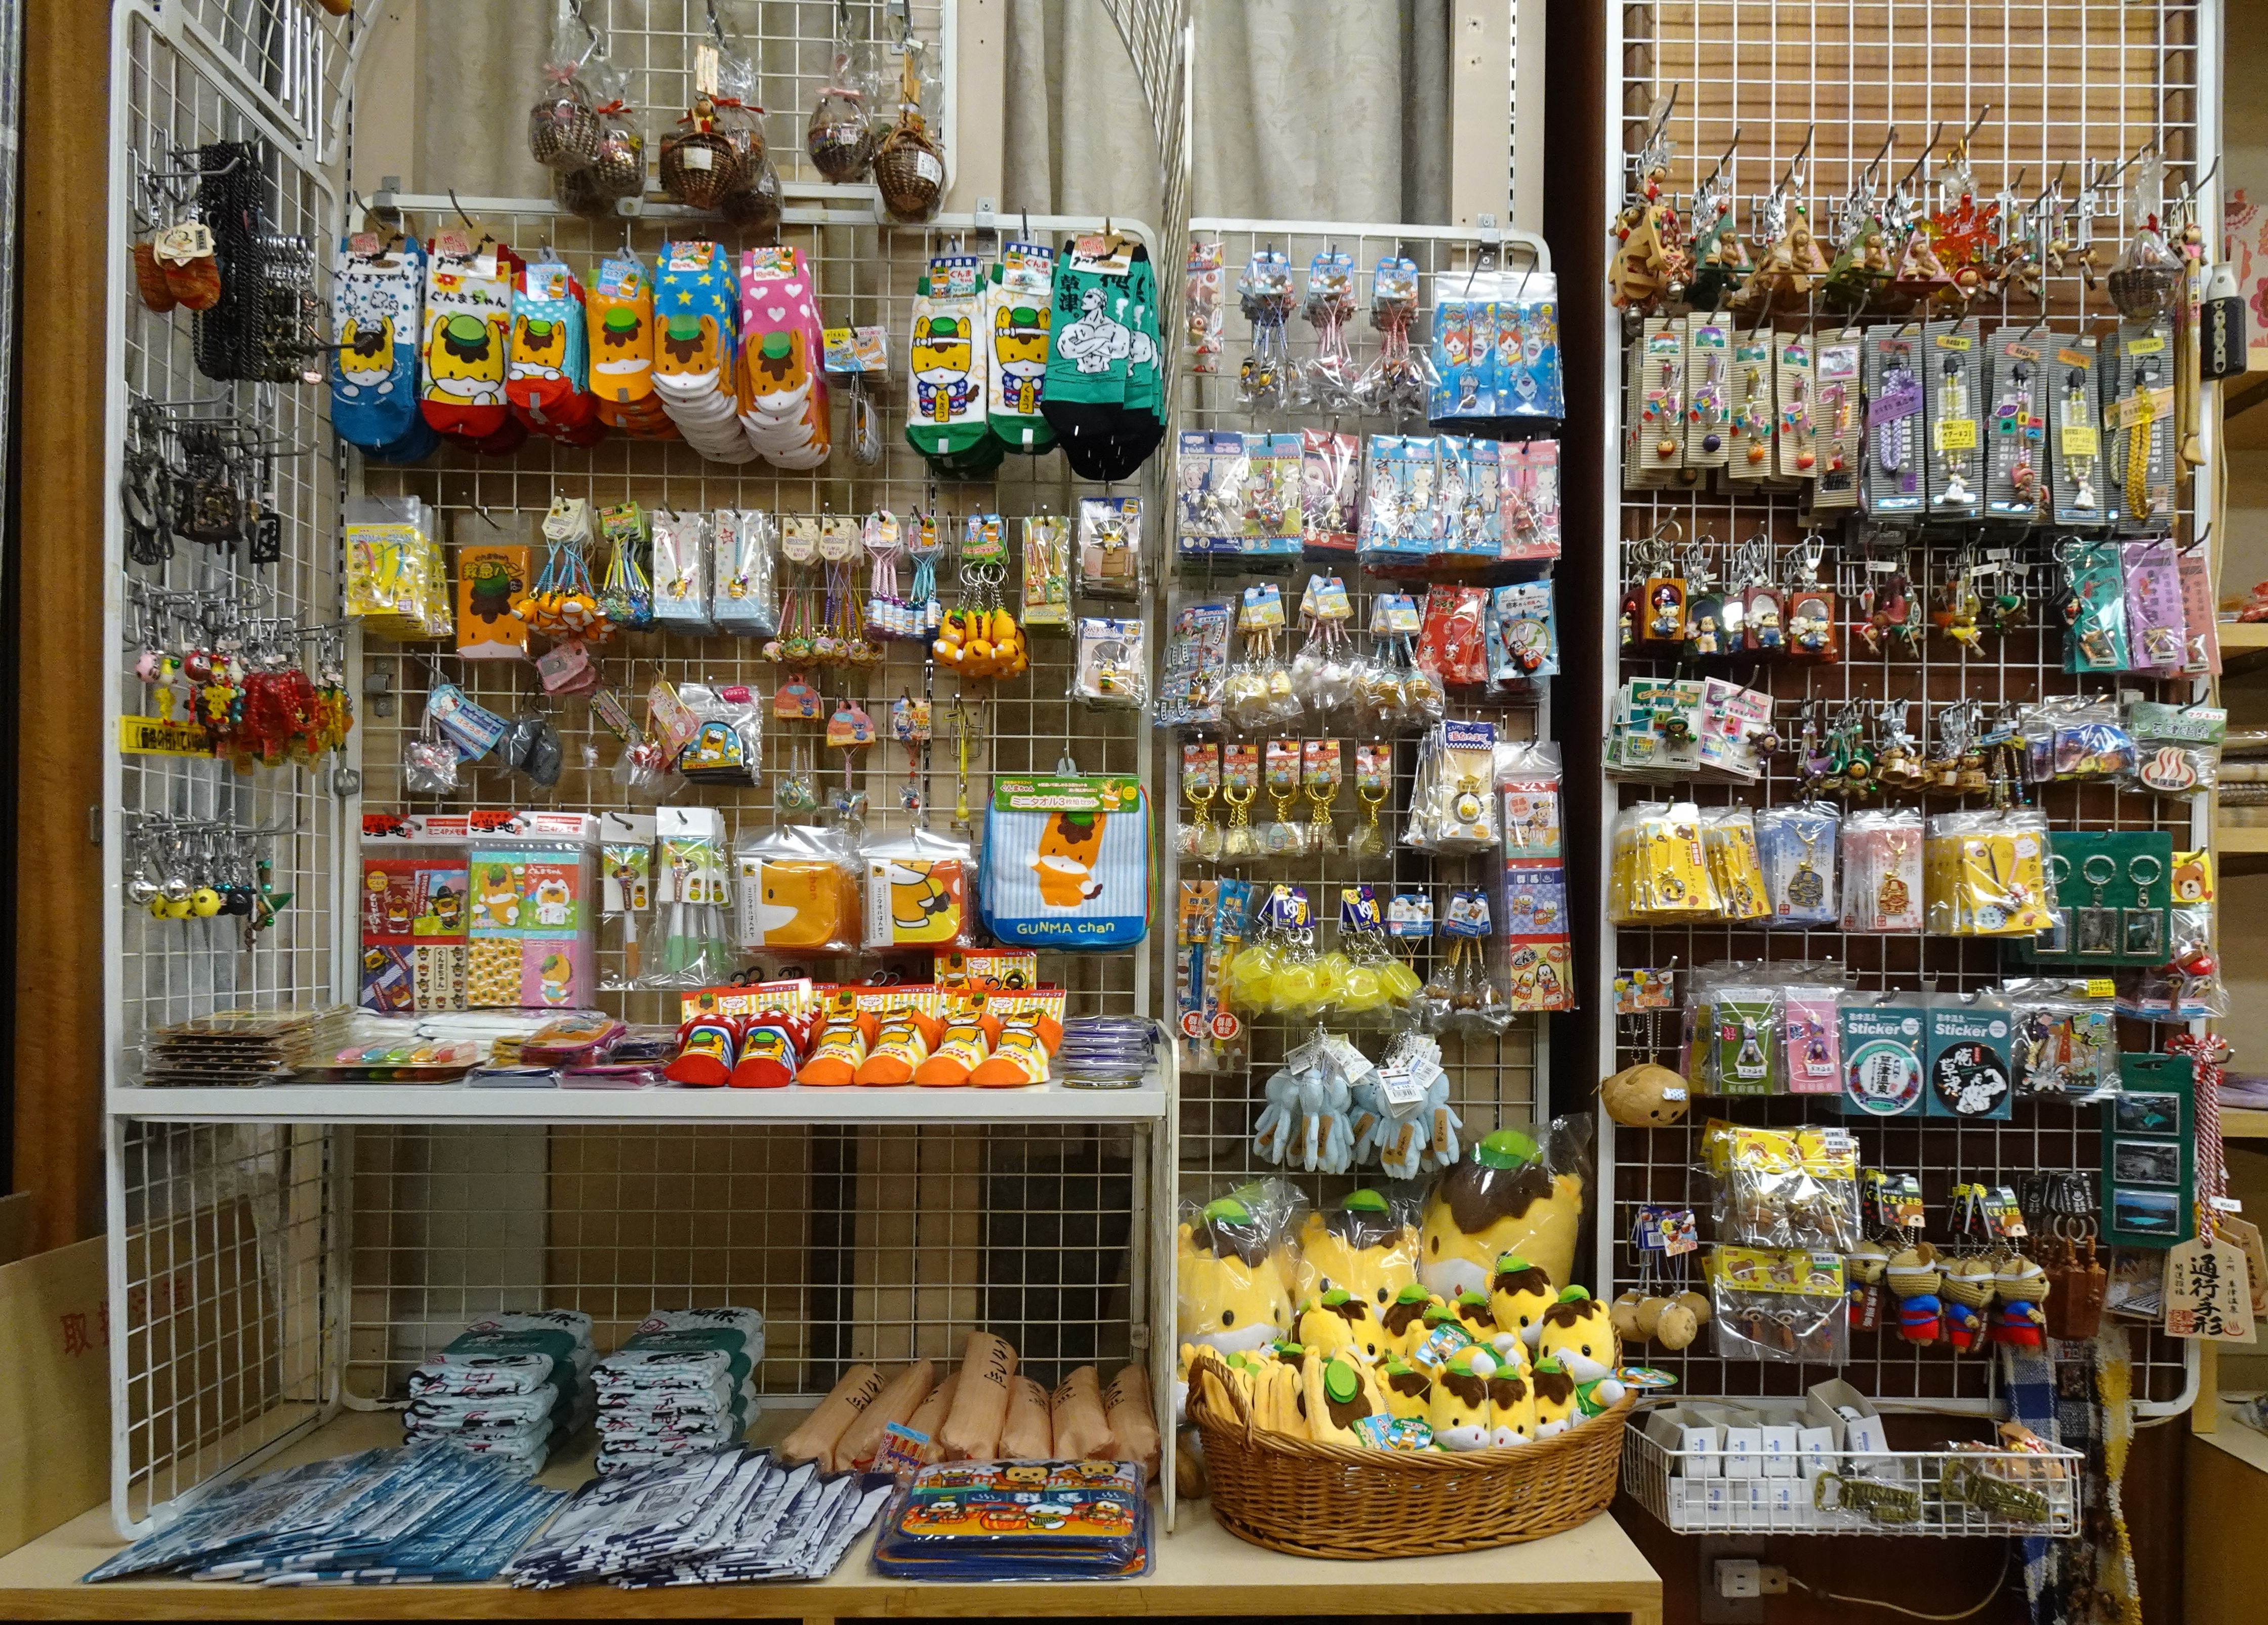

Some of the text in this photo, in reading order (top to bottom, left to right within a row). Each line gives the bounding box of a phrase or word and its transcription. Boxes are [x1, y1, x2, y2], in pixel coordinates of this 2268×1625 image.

[1025, 258, 1049, 269] ぐんま
[950, 269, 973, 278] ぐんま
[431, 291, 507, 308] ぐんまちゃん
[2188, 712, 2223, 720] マグネット
[1448, 732, 1489, 742] 温泉たまご
[2152, 721, 2209, 739] 草津温泉
[1012, 797, 1097, 806] ミニタオル3枚組セット
[1283, 899, 1299, 918] ゆ
[1296, 903, 1306, 923] ケロリン
[1356, 900, 1374, 920] ゆ
[1370, 900, 1380, 921] ケロリン
[1016, 920, 1115, 935] GUNMA chan
[1514, 951, 1539, 967] ぐんま
[437, 950, 445, 988] ぐんまちゃん
[1848, 1022, 1901, 1035] Sticker
[1935, 1023, 1988, 1037] Sticker
[1875, 1055, 1892, 1095] 草津温泉
[1882, 1194, 1923, 1206] くまくまお
[1987, 1207, 2019, 1216] くまくまお
[2190, 1253, 2223, 1335] 通行手形
[2228, 1279, 2239, 1314] 草津温泉
